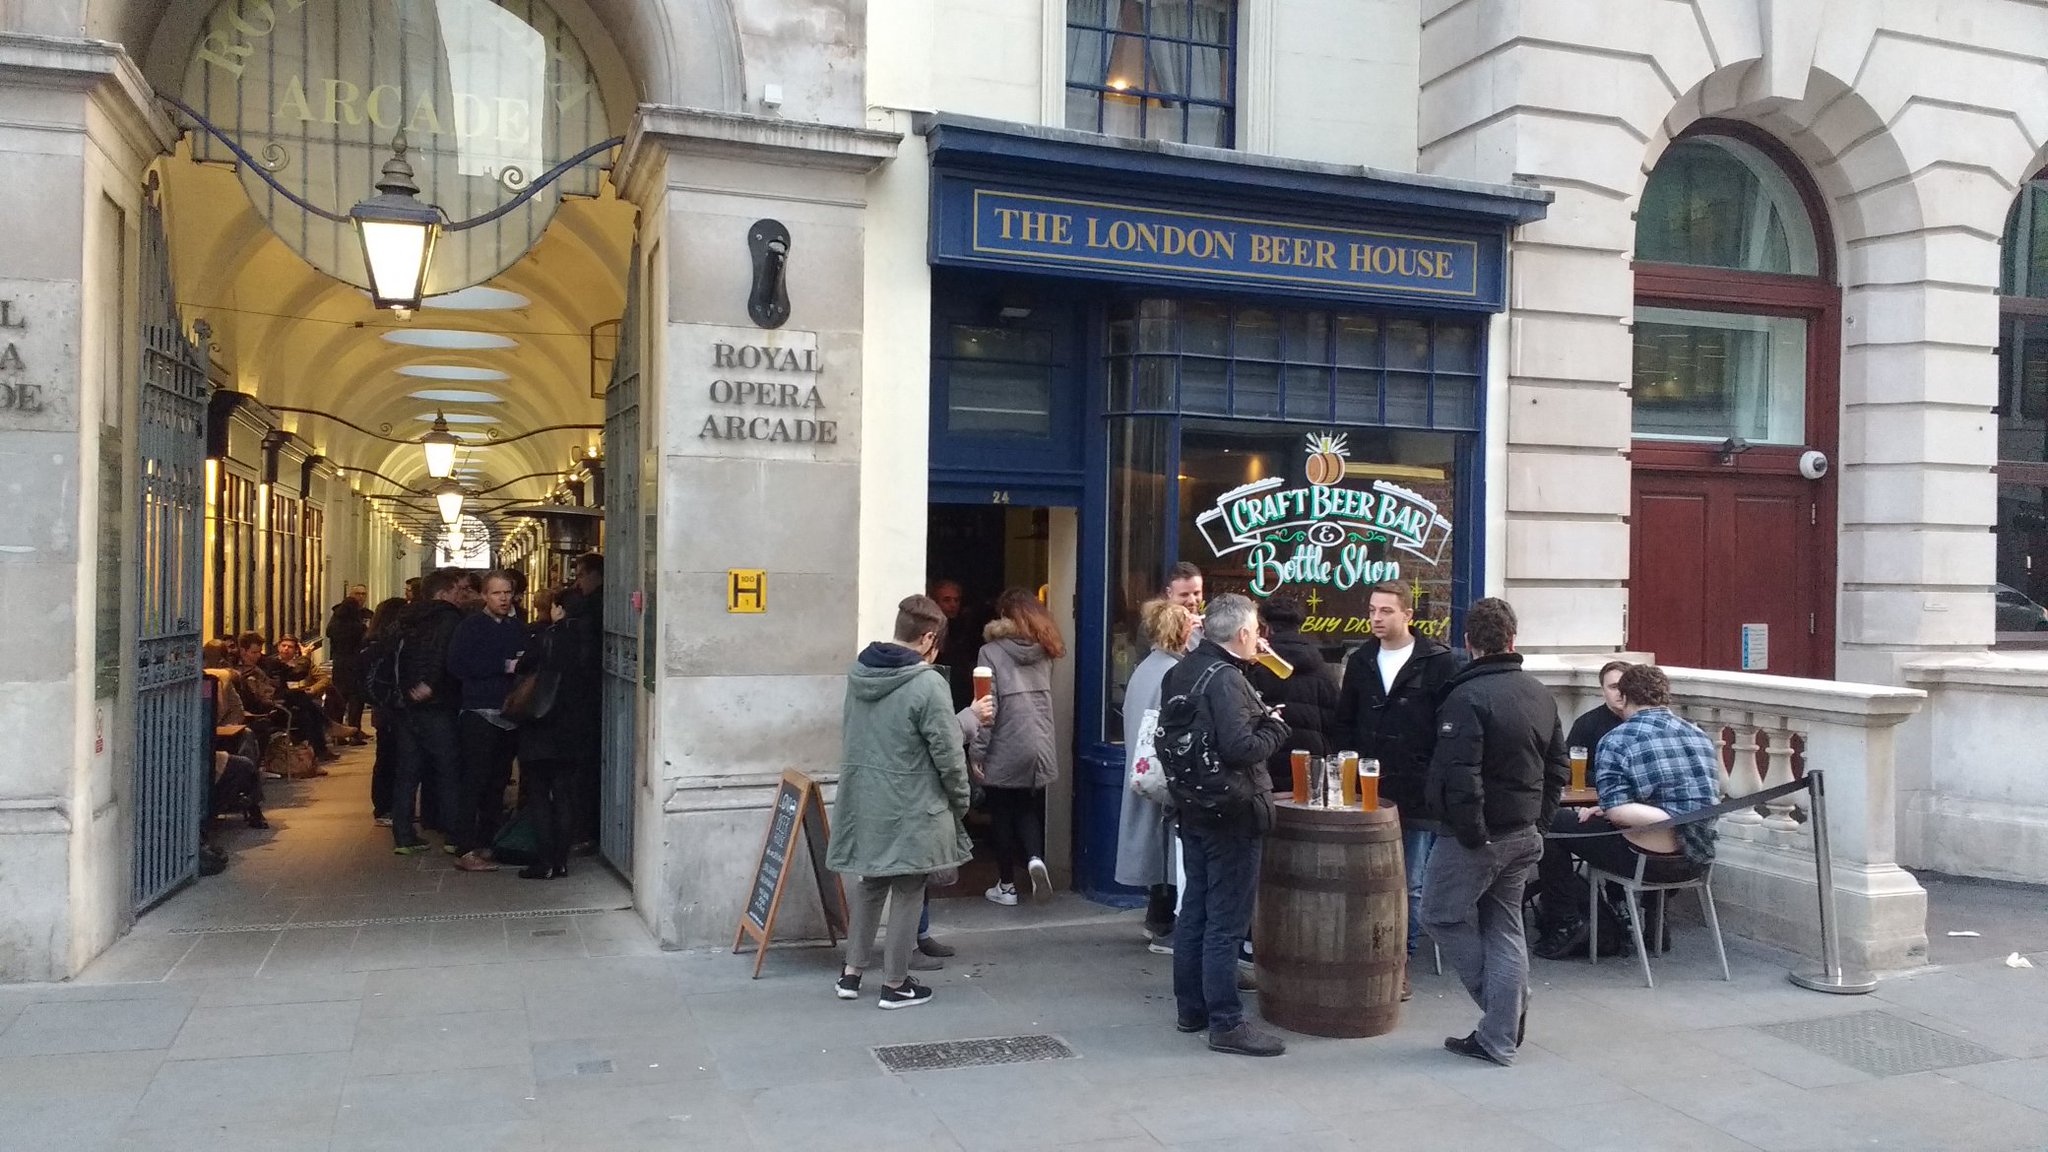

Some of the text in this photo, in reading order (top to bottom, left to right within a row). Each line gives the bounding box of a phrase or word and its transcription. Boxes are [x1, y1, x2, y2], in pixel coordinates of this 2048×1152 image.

[272, 74, 531, 144] ARCADE
[994, 207, 1454, 280] THE LONDON BEER HOUSE
[713, 343, 824, 374] ROYAL
[709, 379, 826, 408] OPERA
[698, 414, 838, 444] ARCADE
[993, 490, 1009, 504] 24
[1232, 485, 1428, 542] CRAFT BEER BAR
[1247, 541, 1332, 597] Bottle
[1299, 616, 1342, 633] BUY
